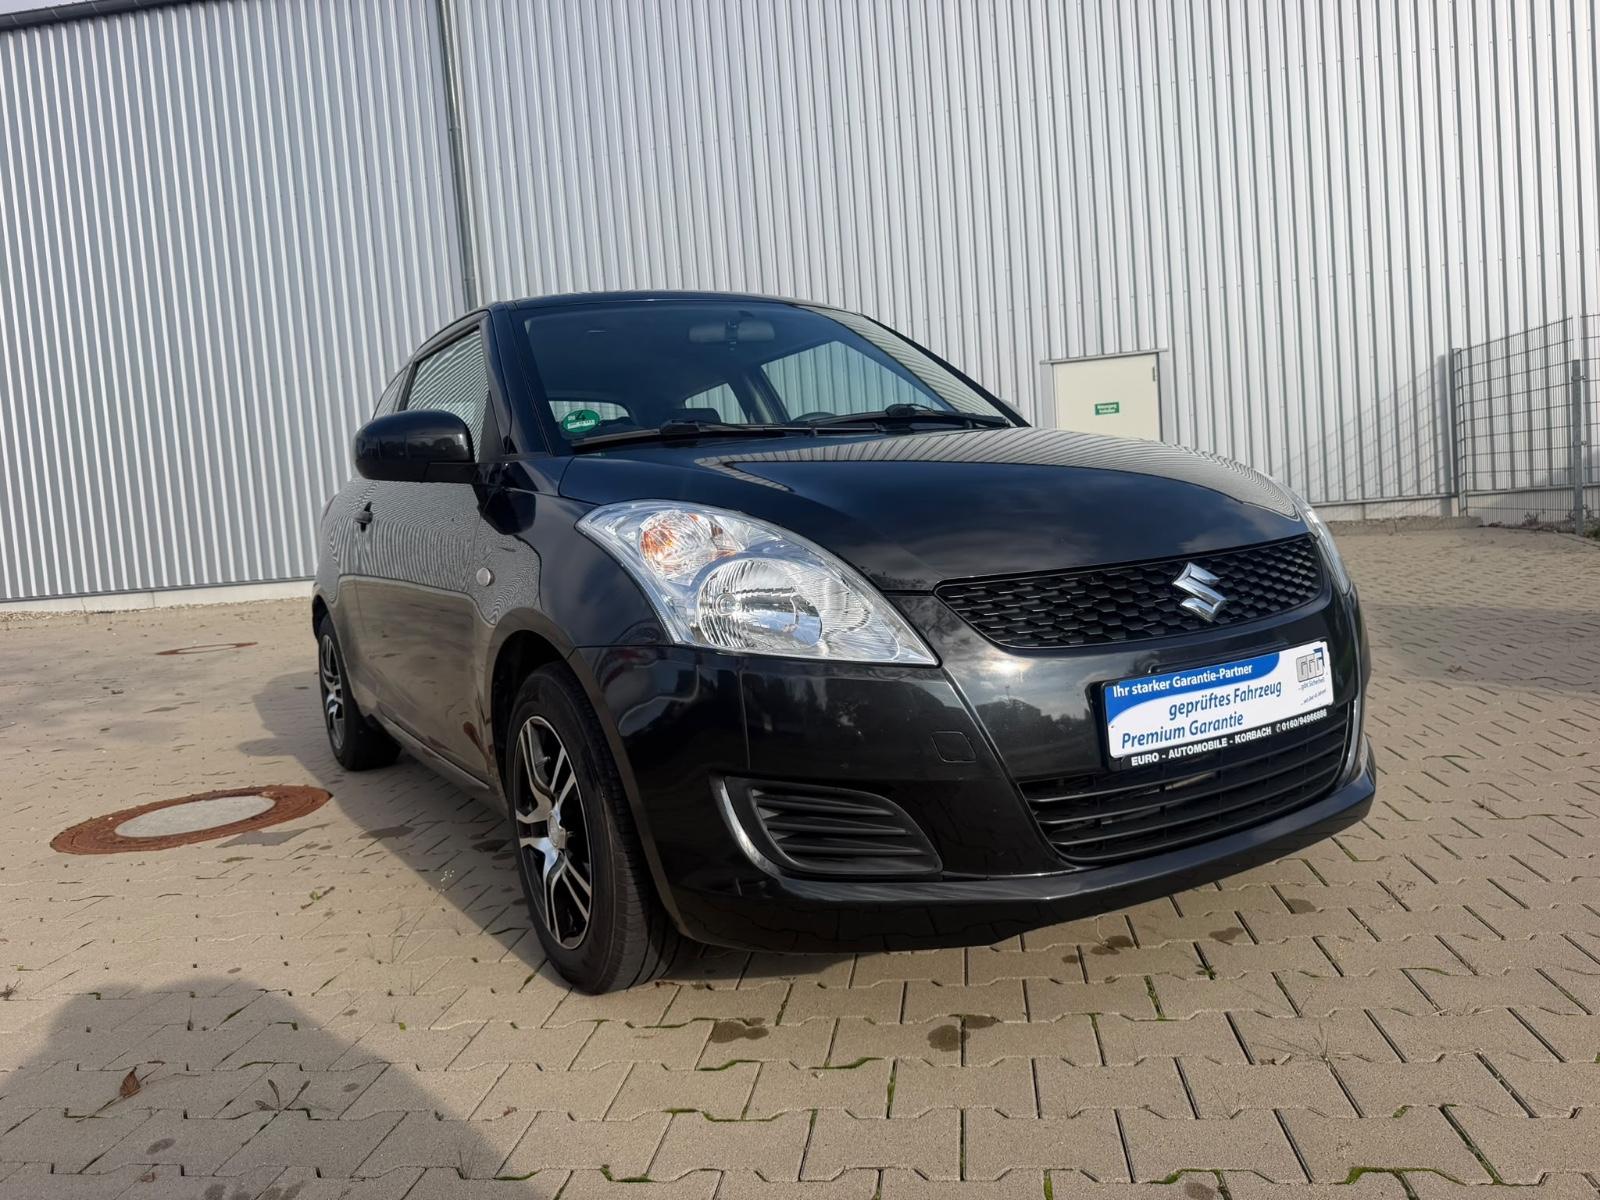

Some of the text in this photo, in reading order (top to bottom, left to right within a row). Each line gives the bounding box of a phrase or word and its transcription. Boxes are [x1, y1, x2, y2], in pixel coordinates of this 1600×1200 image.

[1113, 664, 1253, 698] Ihr starker Garantie-Partner
[1169, 692, 1231, 721] geprüftes
[1233, 681, 1282, 704] Fahrzeug
[1121, 711, 1244, 749] Premium Garantie
[1131, 752, 1160, 767] EURO
[1168, 737, 1228, 759] AUTOMOBILE
[1234, 726, 1272, 744] KORBACH
